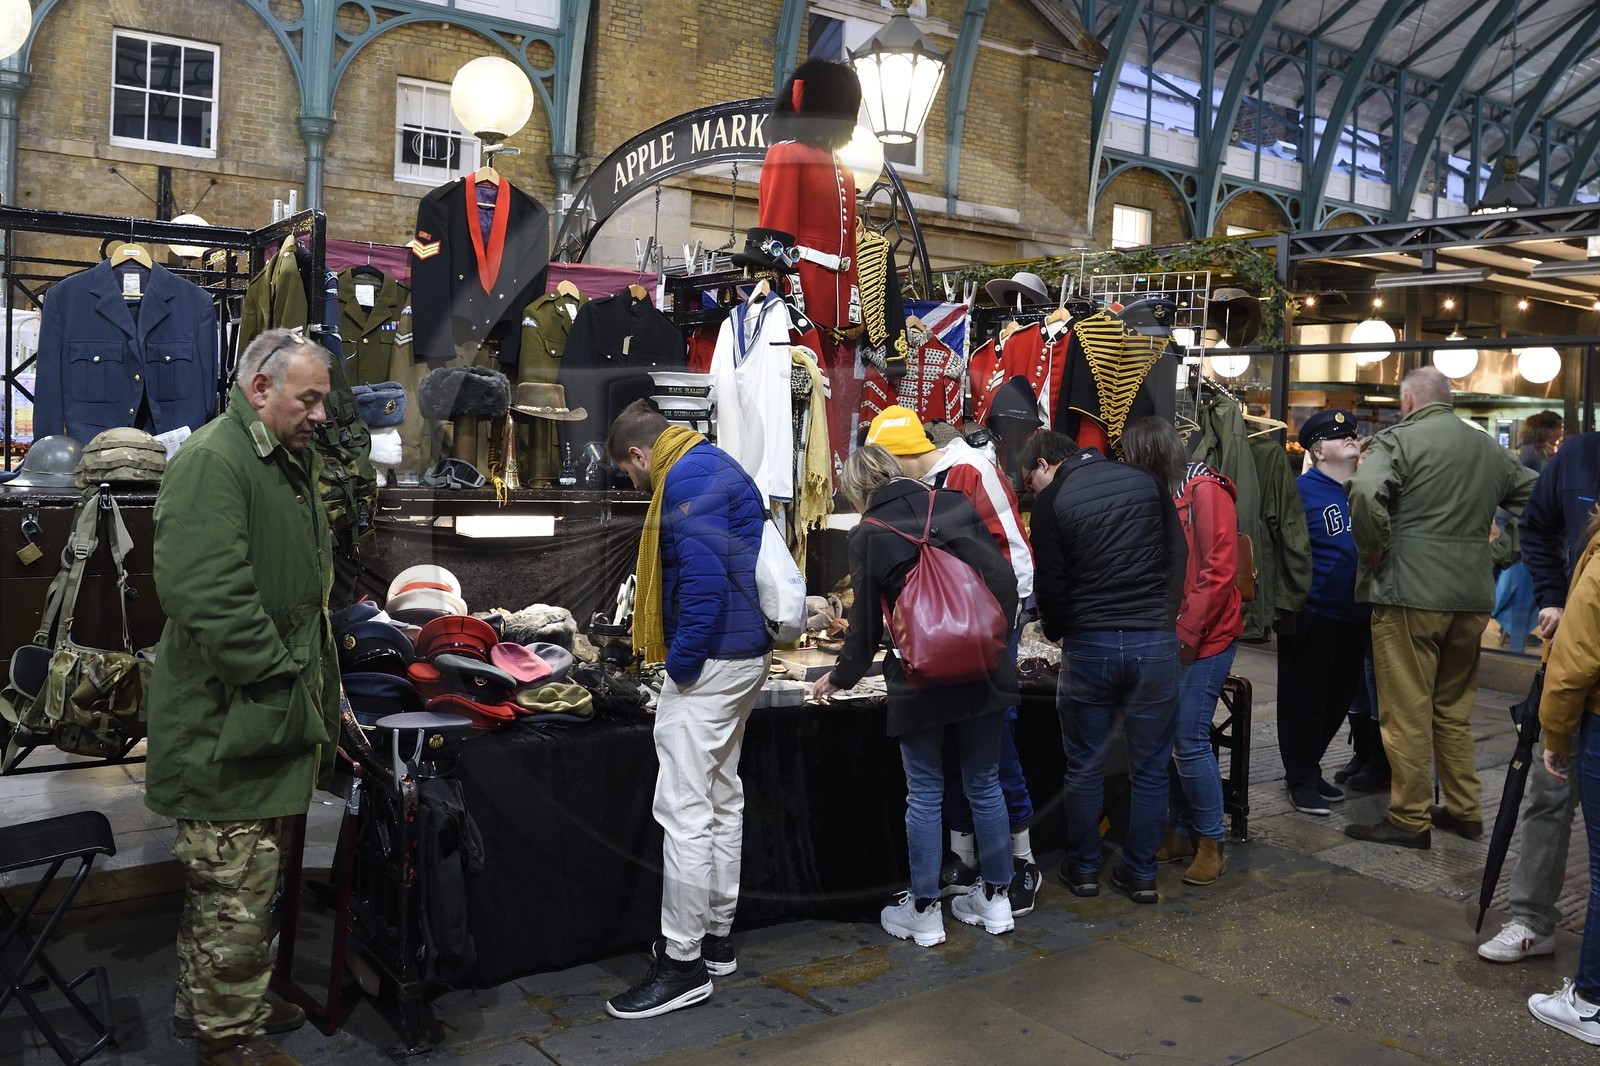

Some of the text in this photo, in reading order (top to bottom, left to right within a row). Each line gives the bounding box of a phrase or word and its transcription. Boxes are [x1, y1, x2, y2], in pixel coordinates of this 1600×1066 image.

[614, 114, 772, 194] APPLE MARK
[1323, 503, 1351, 537] G
